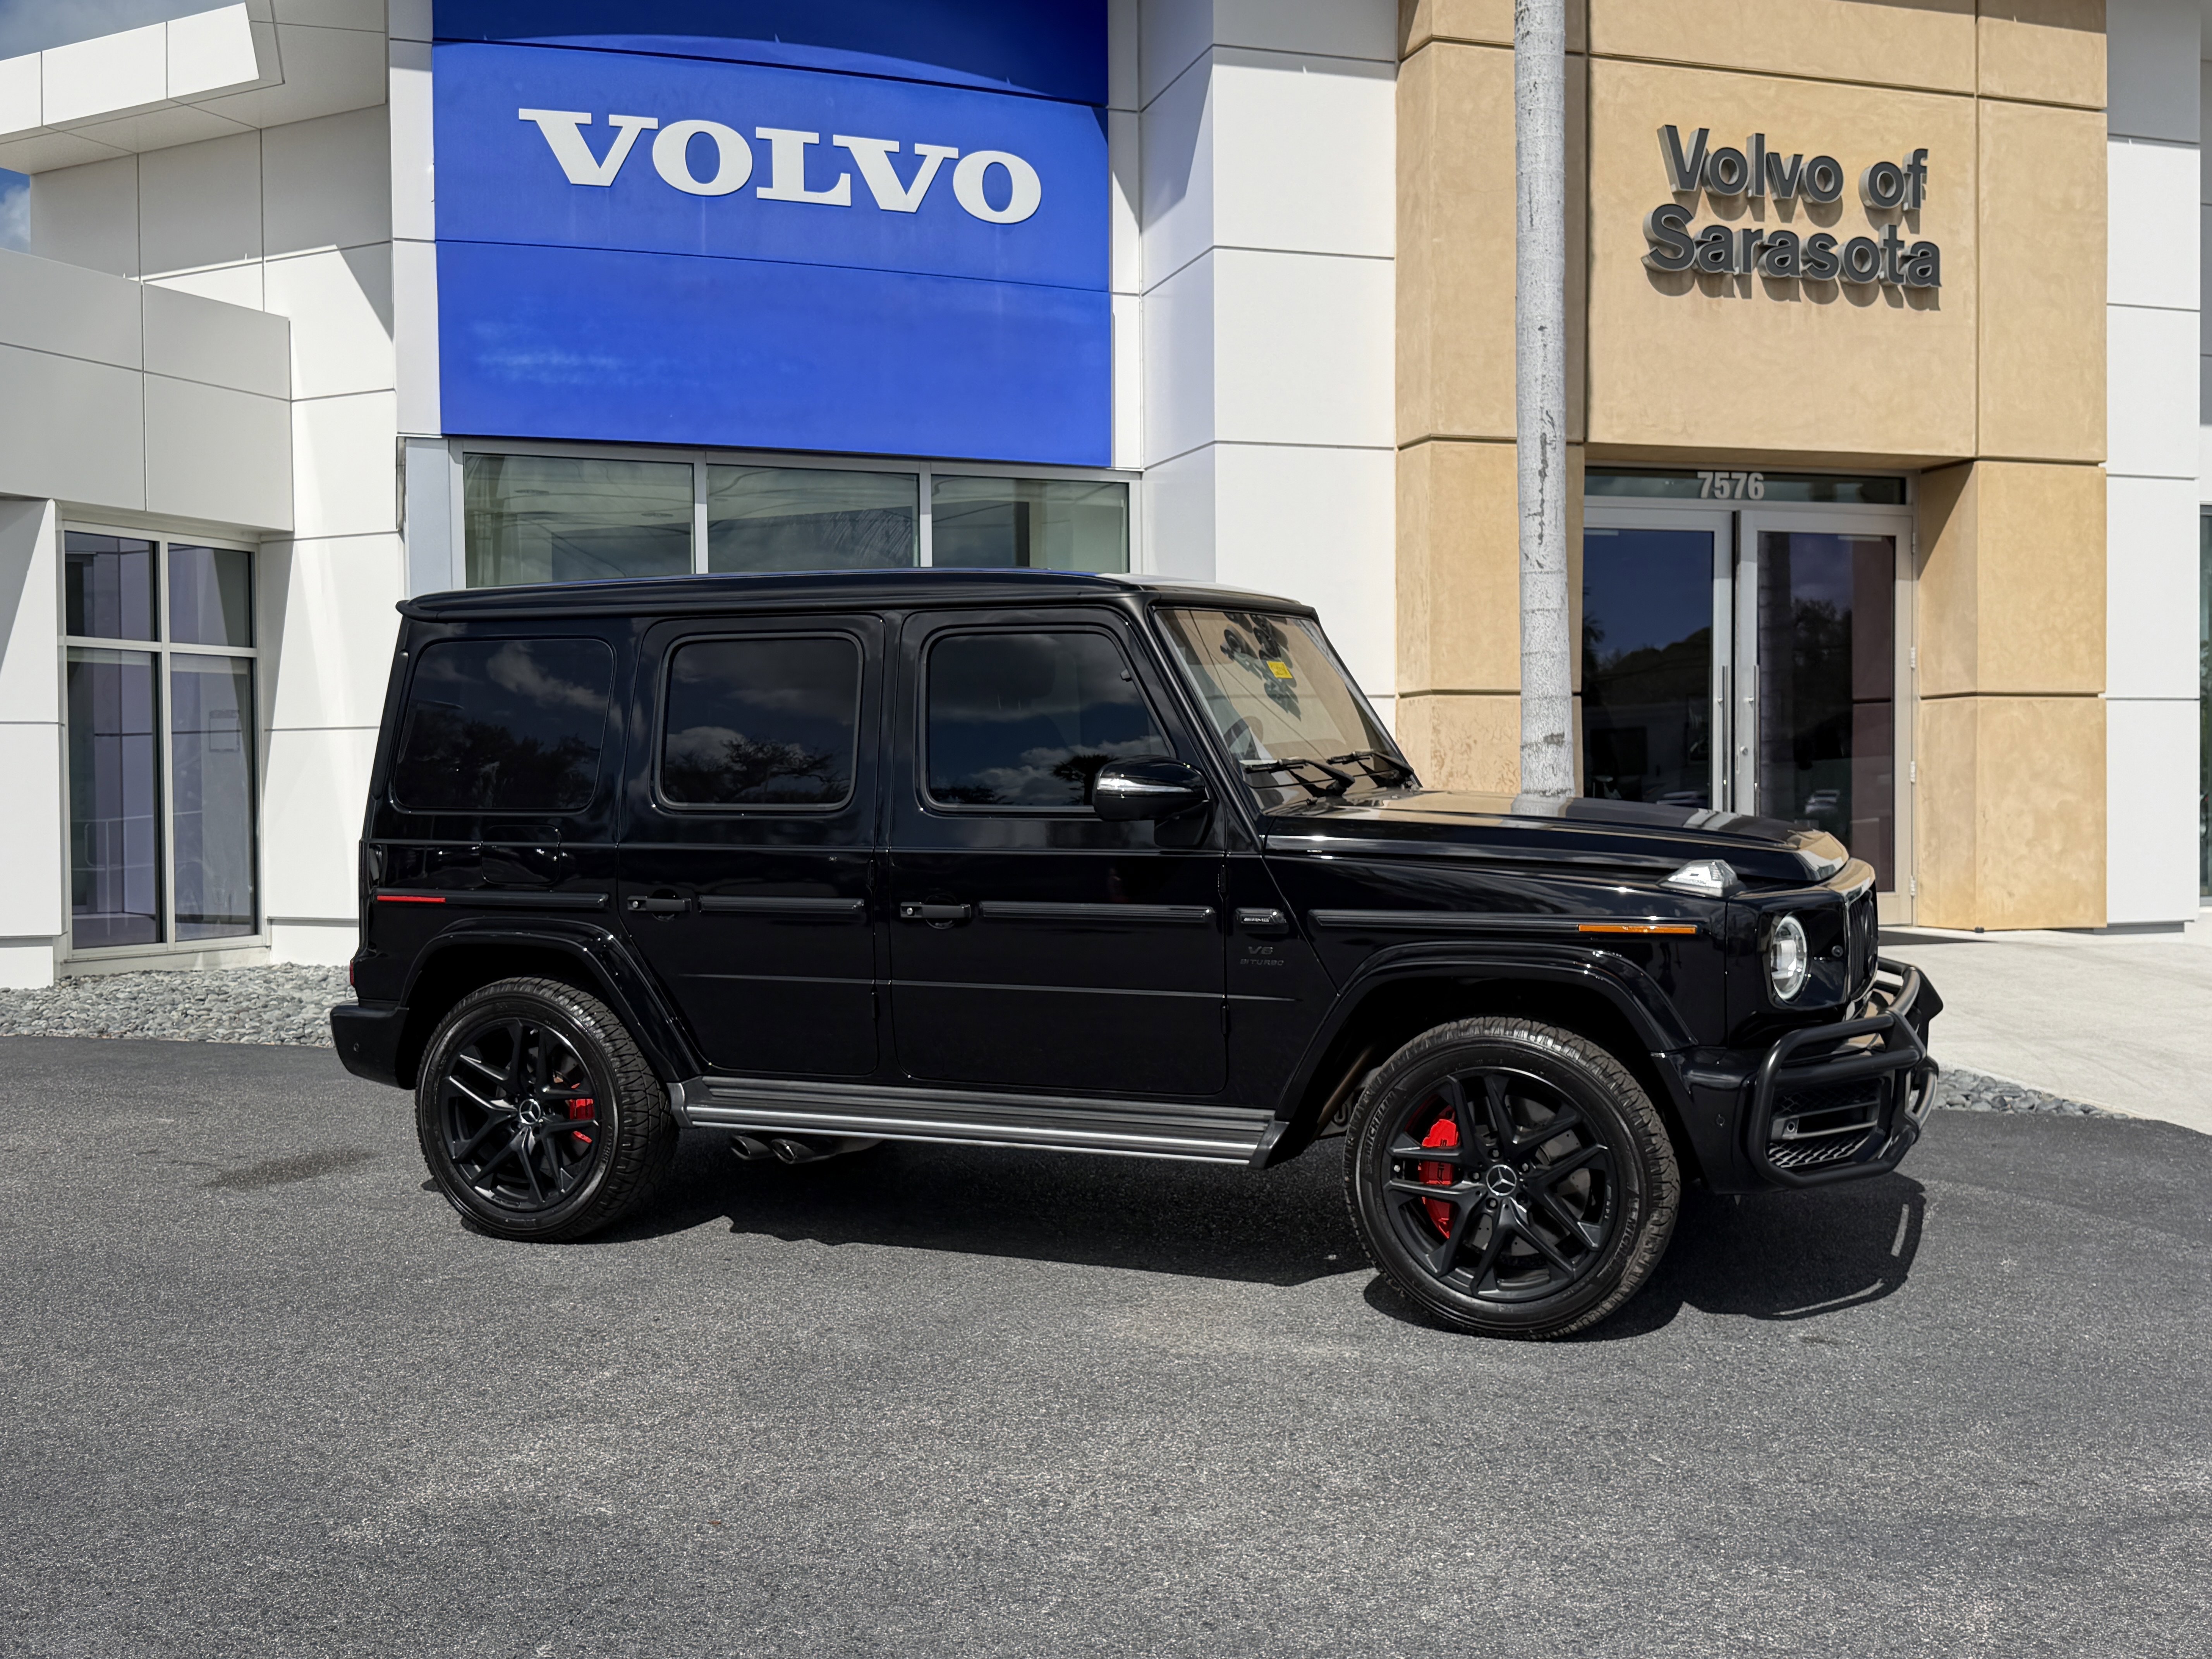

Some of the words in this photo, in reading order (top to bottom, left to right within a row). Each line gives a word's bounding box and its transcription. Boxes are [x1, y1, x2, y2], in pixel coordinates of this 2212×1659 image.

[519, 108, 1041, 223] VOLVO
[1657, 124, 1843, 203] Volvo
[1859, 148, 1928, 210] of
[1641, 204, 1942, 287] Sarasota
[1697, 472, 1765, 500] 7576
[1364, 1090, 1397, 1157] MICHELIN
